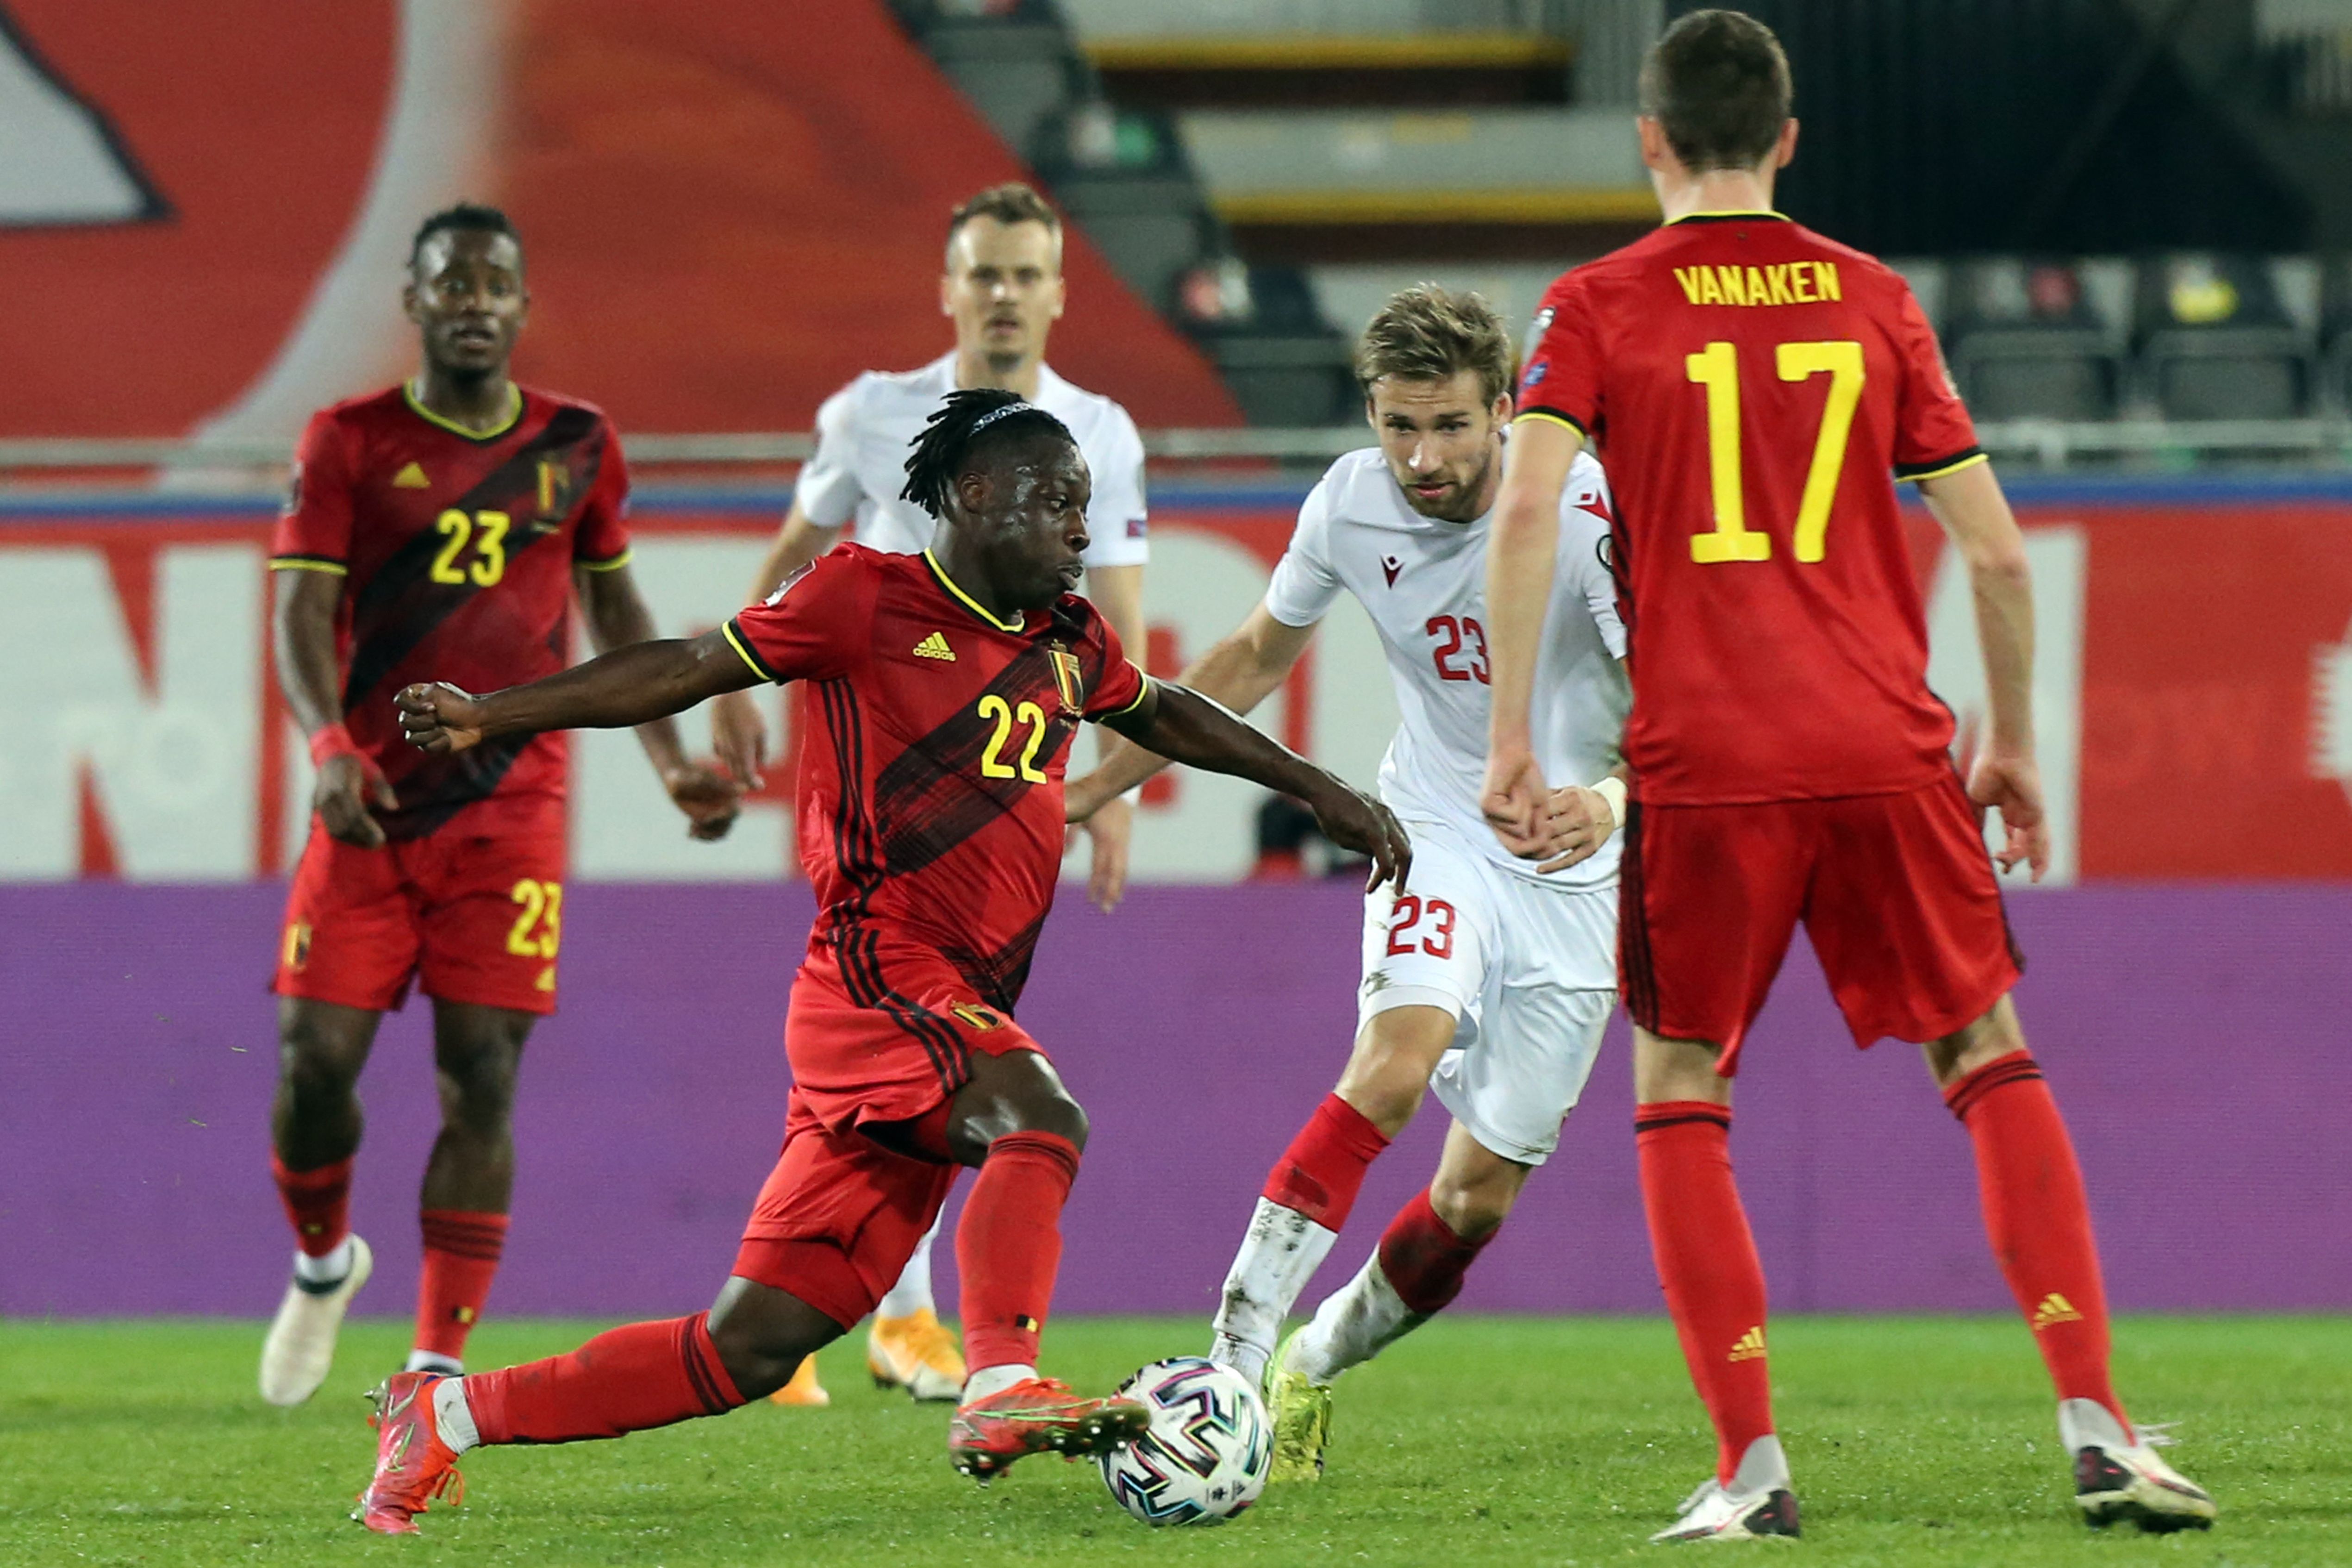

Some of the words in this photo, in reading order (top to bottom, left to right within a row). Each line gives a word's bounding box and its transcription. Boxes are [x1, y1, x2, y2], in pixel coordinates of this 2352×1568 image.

[1673, 261, 1842, 306] VANAKEN
[1685, 340, 1865, 564] 17
[432, 509, 510, 587] 23
[1425, 614, 1491, 685] 23
[977, 694, 1048, 784] 22
[1386, 895, 1455, 959] 23
